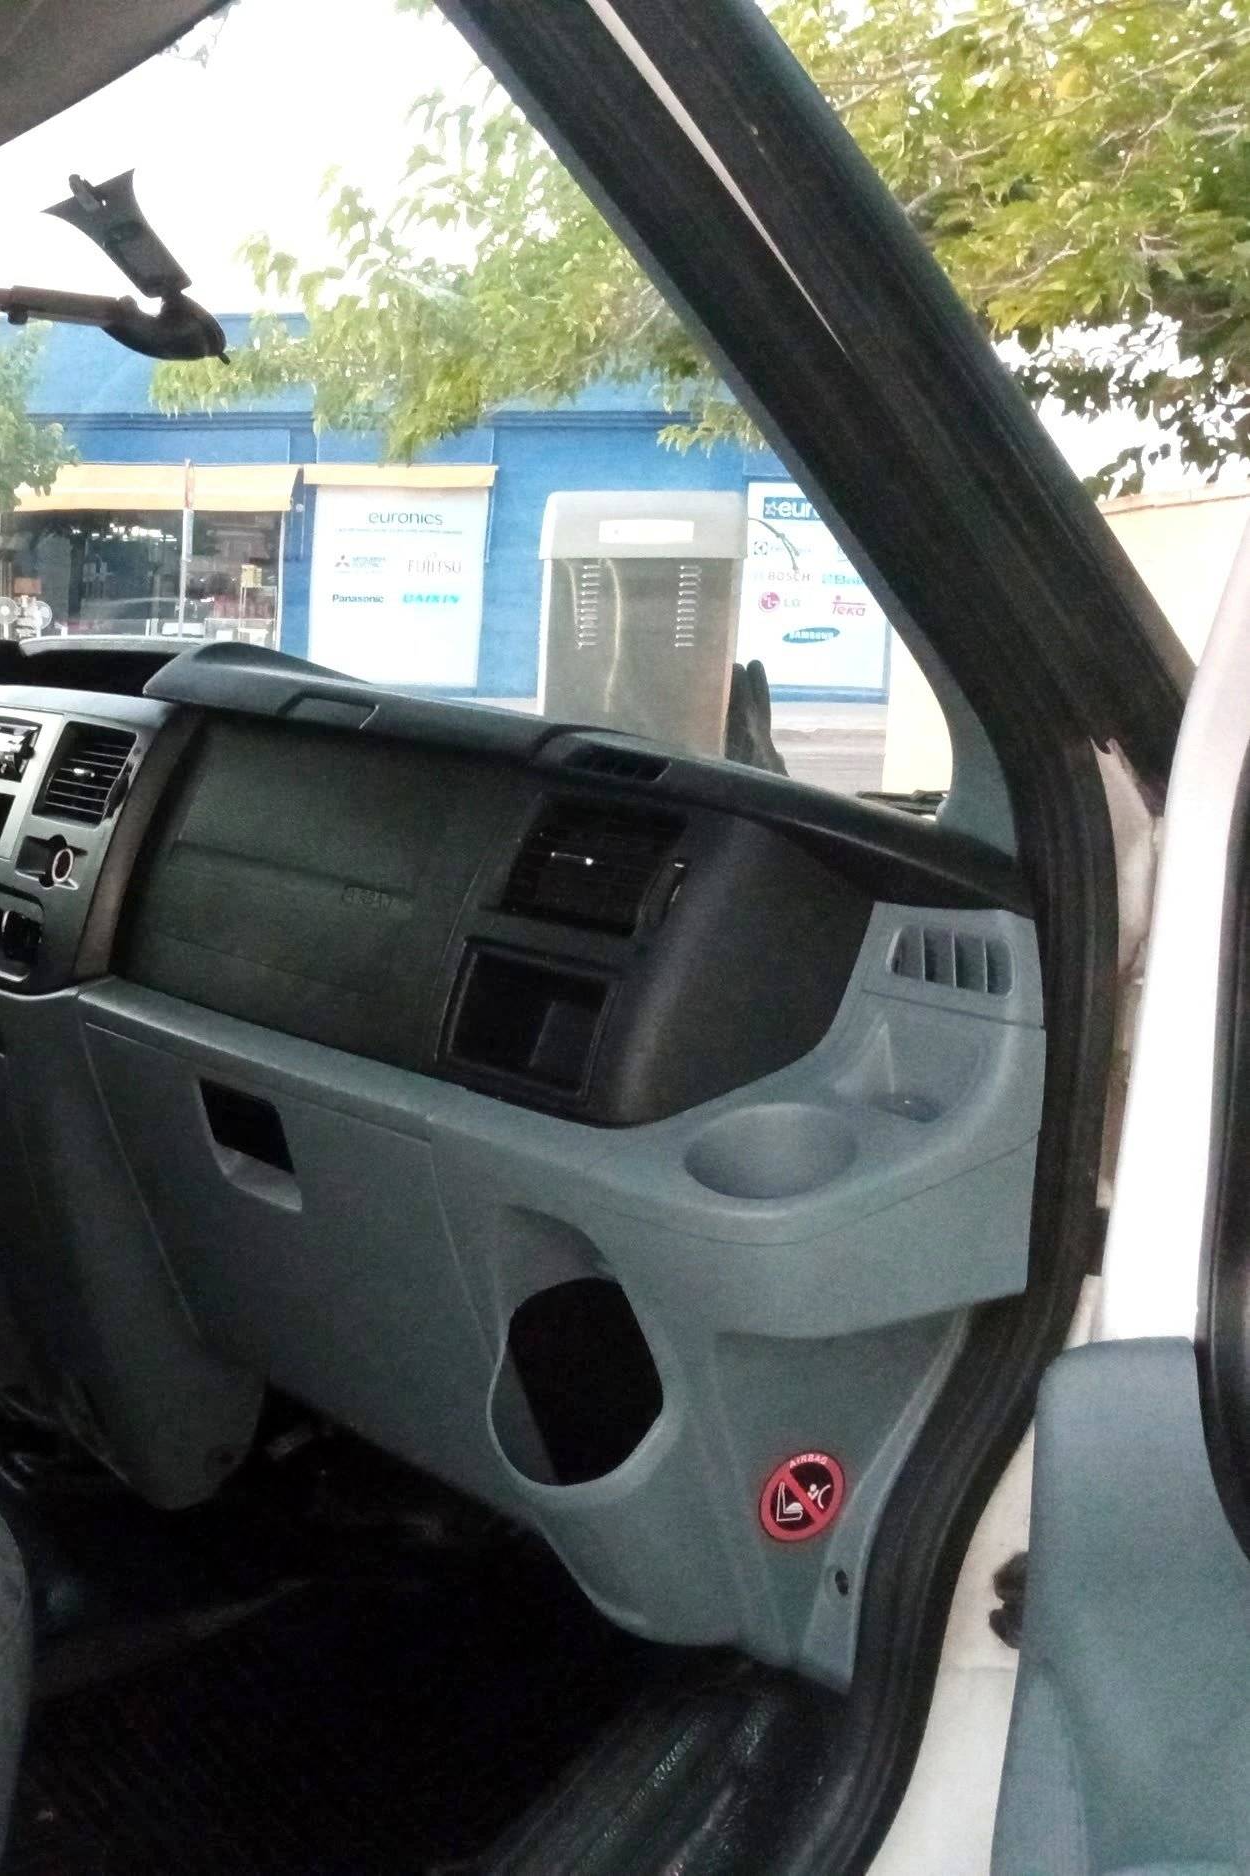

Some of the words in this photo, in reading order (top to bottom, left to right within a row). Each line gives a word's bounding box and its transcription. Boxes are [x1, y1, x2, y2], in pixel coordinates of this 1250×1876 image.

[368, 511, 444, 526] euronics
[407, 559, 462, 576] FUJITSU
[767, 571, 811, 582] BOSCH
[332, 593, 385, 604] Panasonic
[788, 630, 834, 642] SAMSUNG
[789, 1453, 830, 1469] AIRBAG
